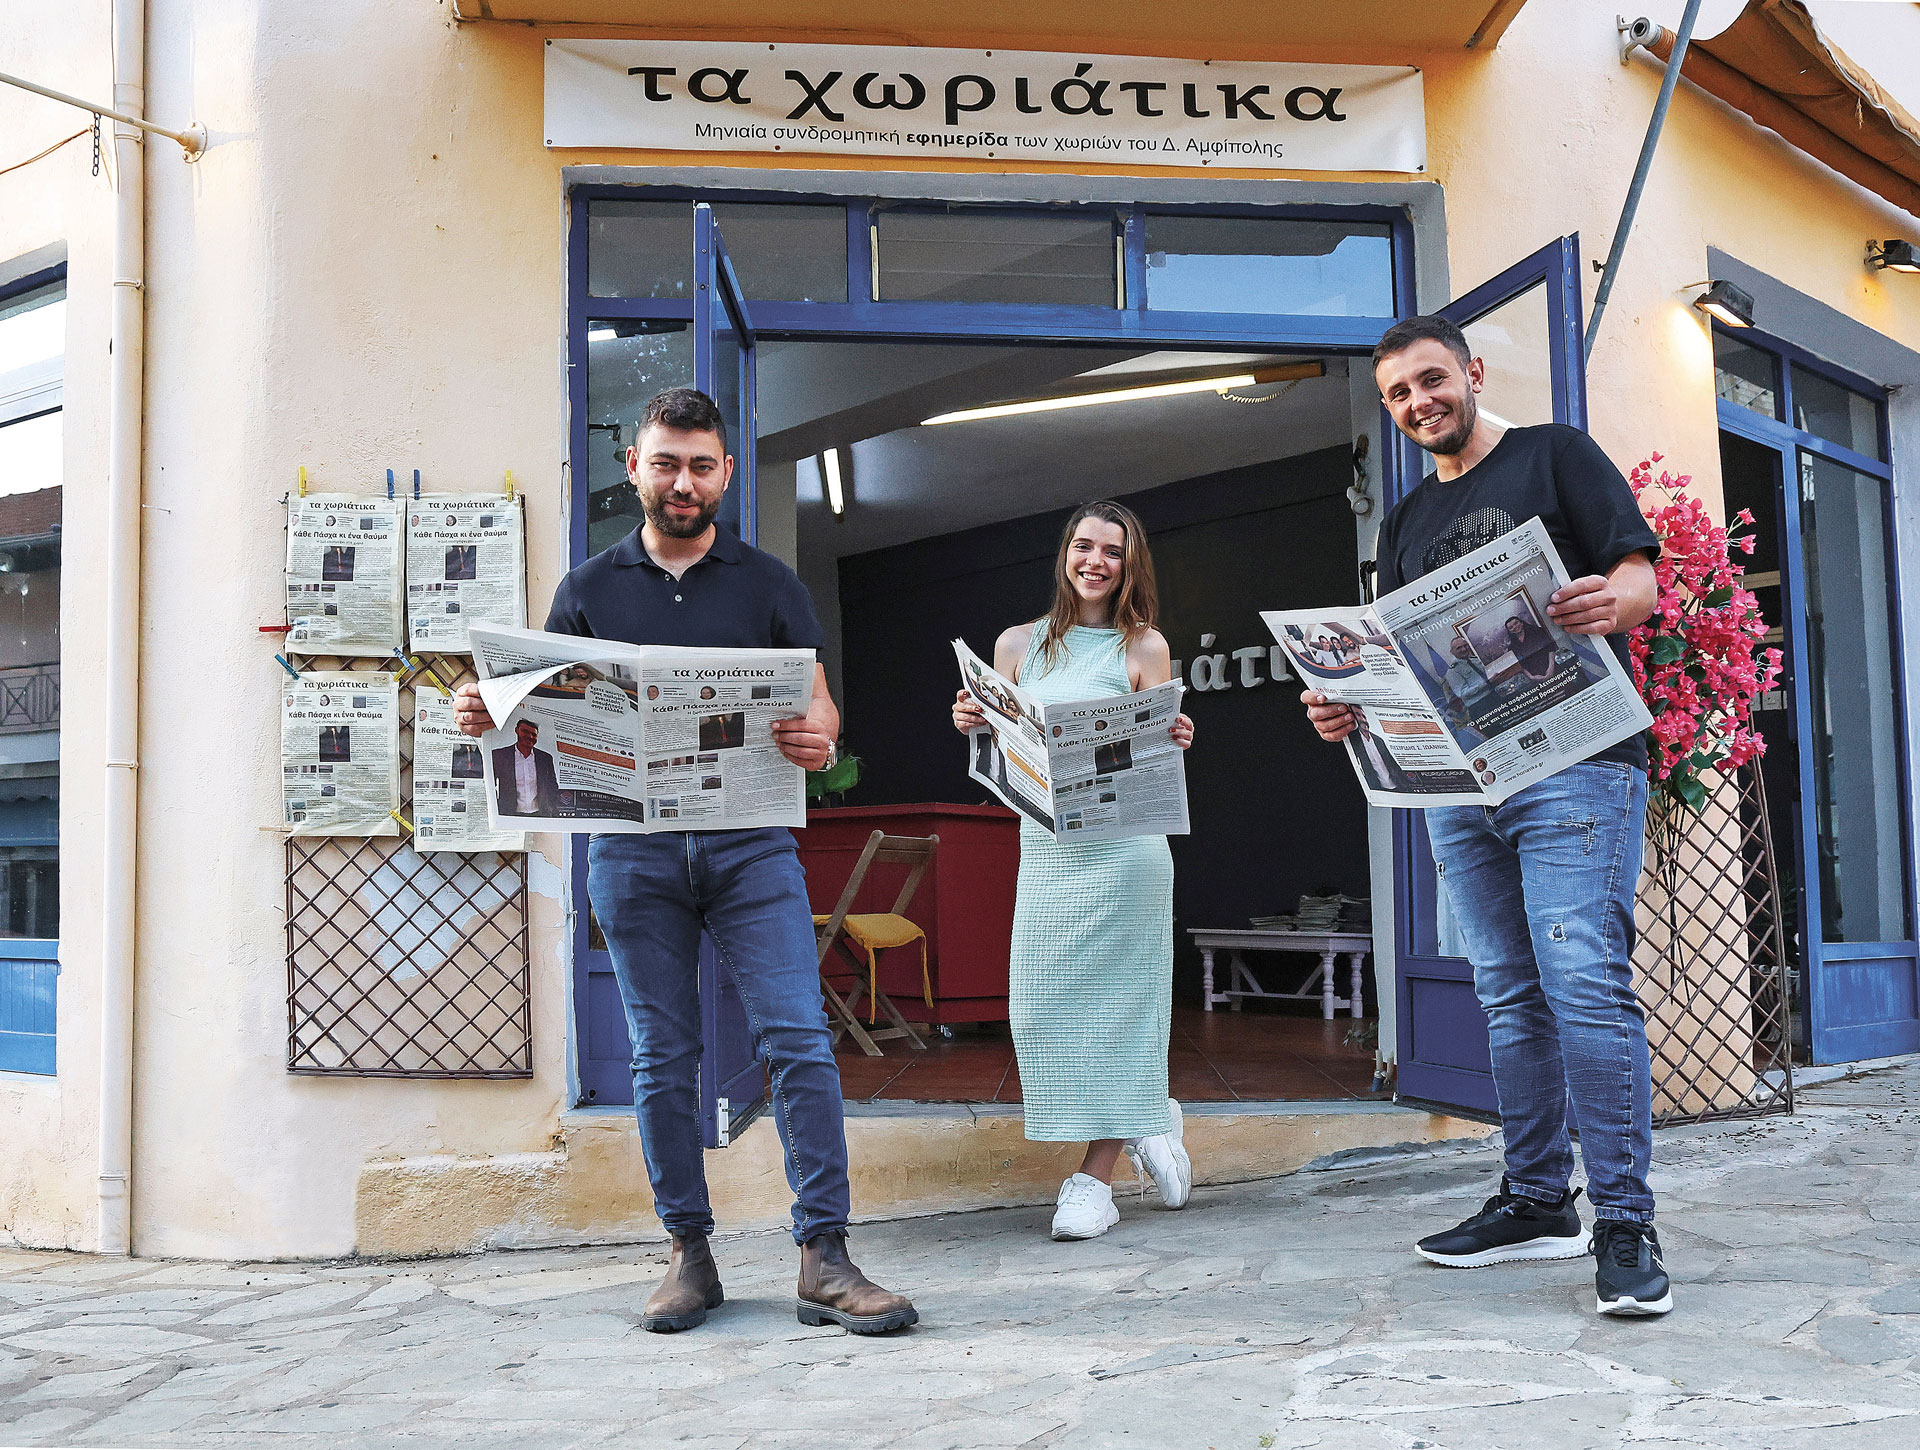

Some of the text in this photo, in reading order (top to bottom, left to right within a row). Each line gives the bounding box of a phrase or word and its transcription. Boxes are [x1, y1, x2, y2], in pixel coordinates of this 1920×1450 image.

[627, 62, 1347, 126] τα χωριάτικα
[694, 123, 1284, 158] Μηνιαία συνδρομητική εφημερίδα των χωριών του Δ. Αμφίπολης
[309, 501, 376, 512] τα χωριάτικα
[428, 500, 496, 512] τα χωριάτικα
[293, 530, 312, 538] Κάθε
[313, 530, 337, 540] Πάσχα
[348, 531, 361, 540] ένα
[363, 532, 388, 541] θαύμα
[414, 529, 433, 538] Κάθε
[434, 530, 458, 540] Πάσχα
[469, 530, 483, 538] ένα
[484, 529, 508, 539] θαύμα
[1408, 551, 1510, 608] τα χωριάτικα
[1402, 614, 1455, 644] Στρατηγός
[672, 666, 775, 679] τα χωριάτικα
[303, 679, 369, 690] τα χωριάτικα
[437, 697, 449, 706] τα
[652, 704, 680, 713] Κάθε
[682, 702, 719, 710] Πάσχα
[756, 700, 793, 708] θαύμα
[1071, 697, 1153, 718] τα χωριάτικα
[288, 711, 307, 719] Κάθε
[308, 710, 332, 720] Πάσχα
[341, 710, 356, 719] ένα
[356, 710, 383, 720] θαύμα
[421, 726, 441, 735] Κάθε
[1057, 739, 1080, 750] Κάθε
[1081, 733, 1111, 744] Πάσχα
[1122, 725, 1138, 734] ένα
[1139, 717, 1168, 731] θαύμα
